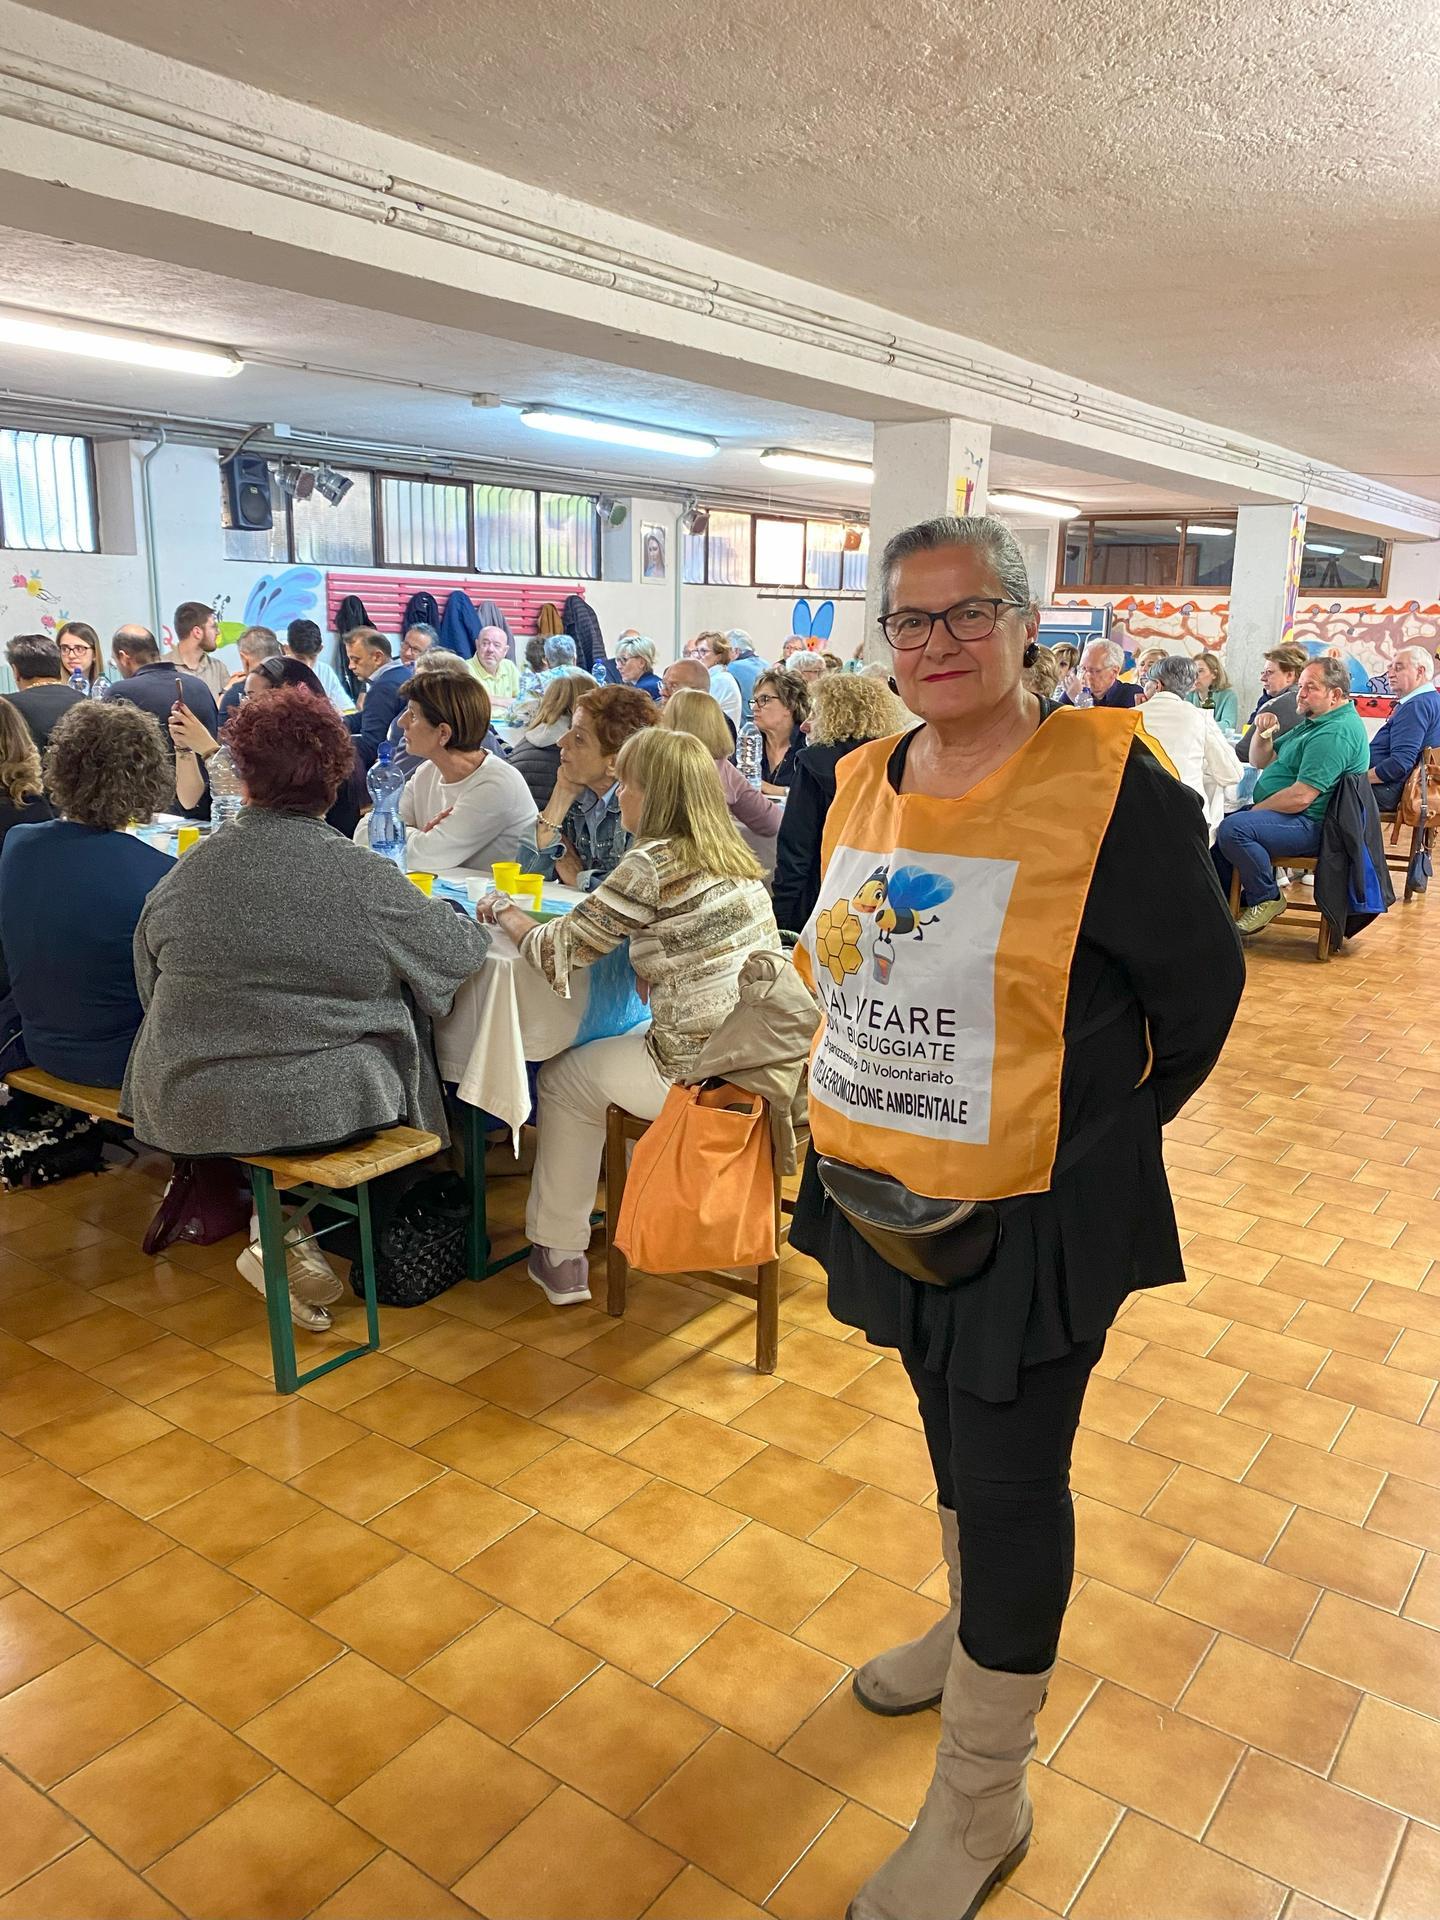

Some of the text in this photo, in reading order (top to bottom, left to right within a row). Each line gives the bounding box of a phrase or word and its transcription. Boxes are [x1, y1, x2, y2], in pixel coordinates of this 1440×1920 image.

[860, 1059, 870, 1075] Di
[873, 1064, 954, 1085] Volontariato
[886, 1090, 969, 1125] AMBIENTALE
